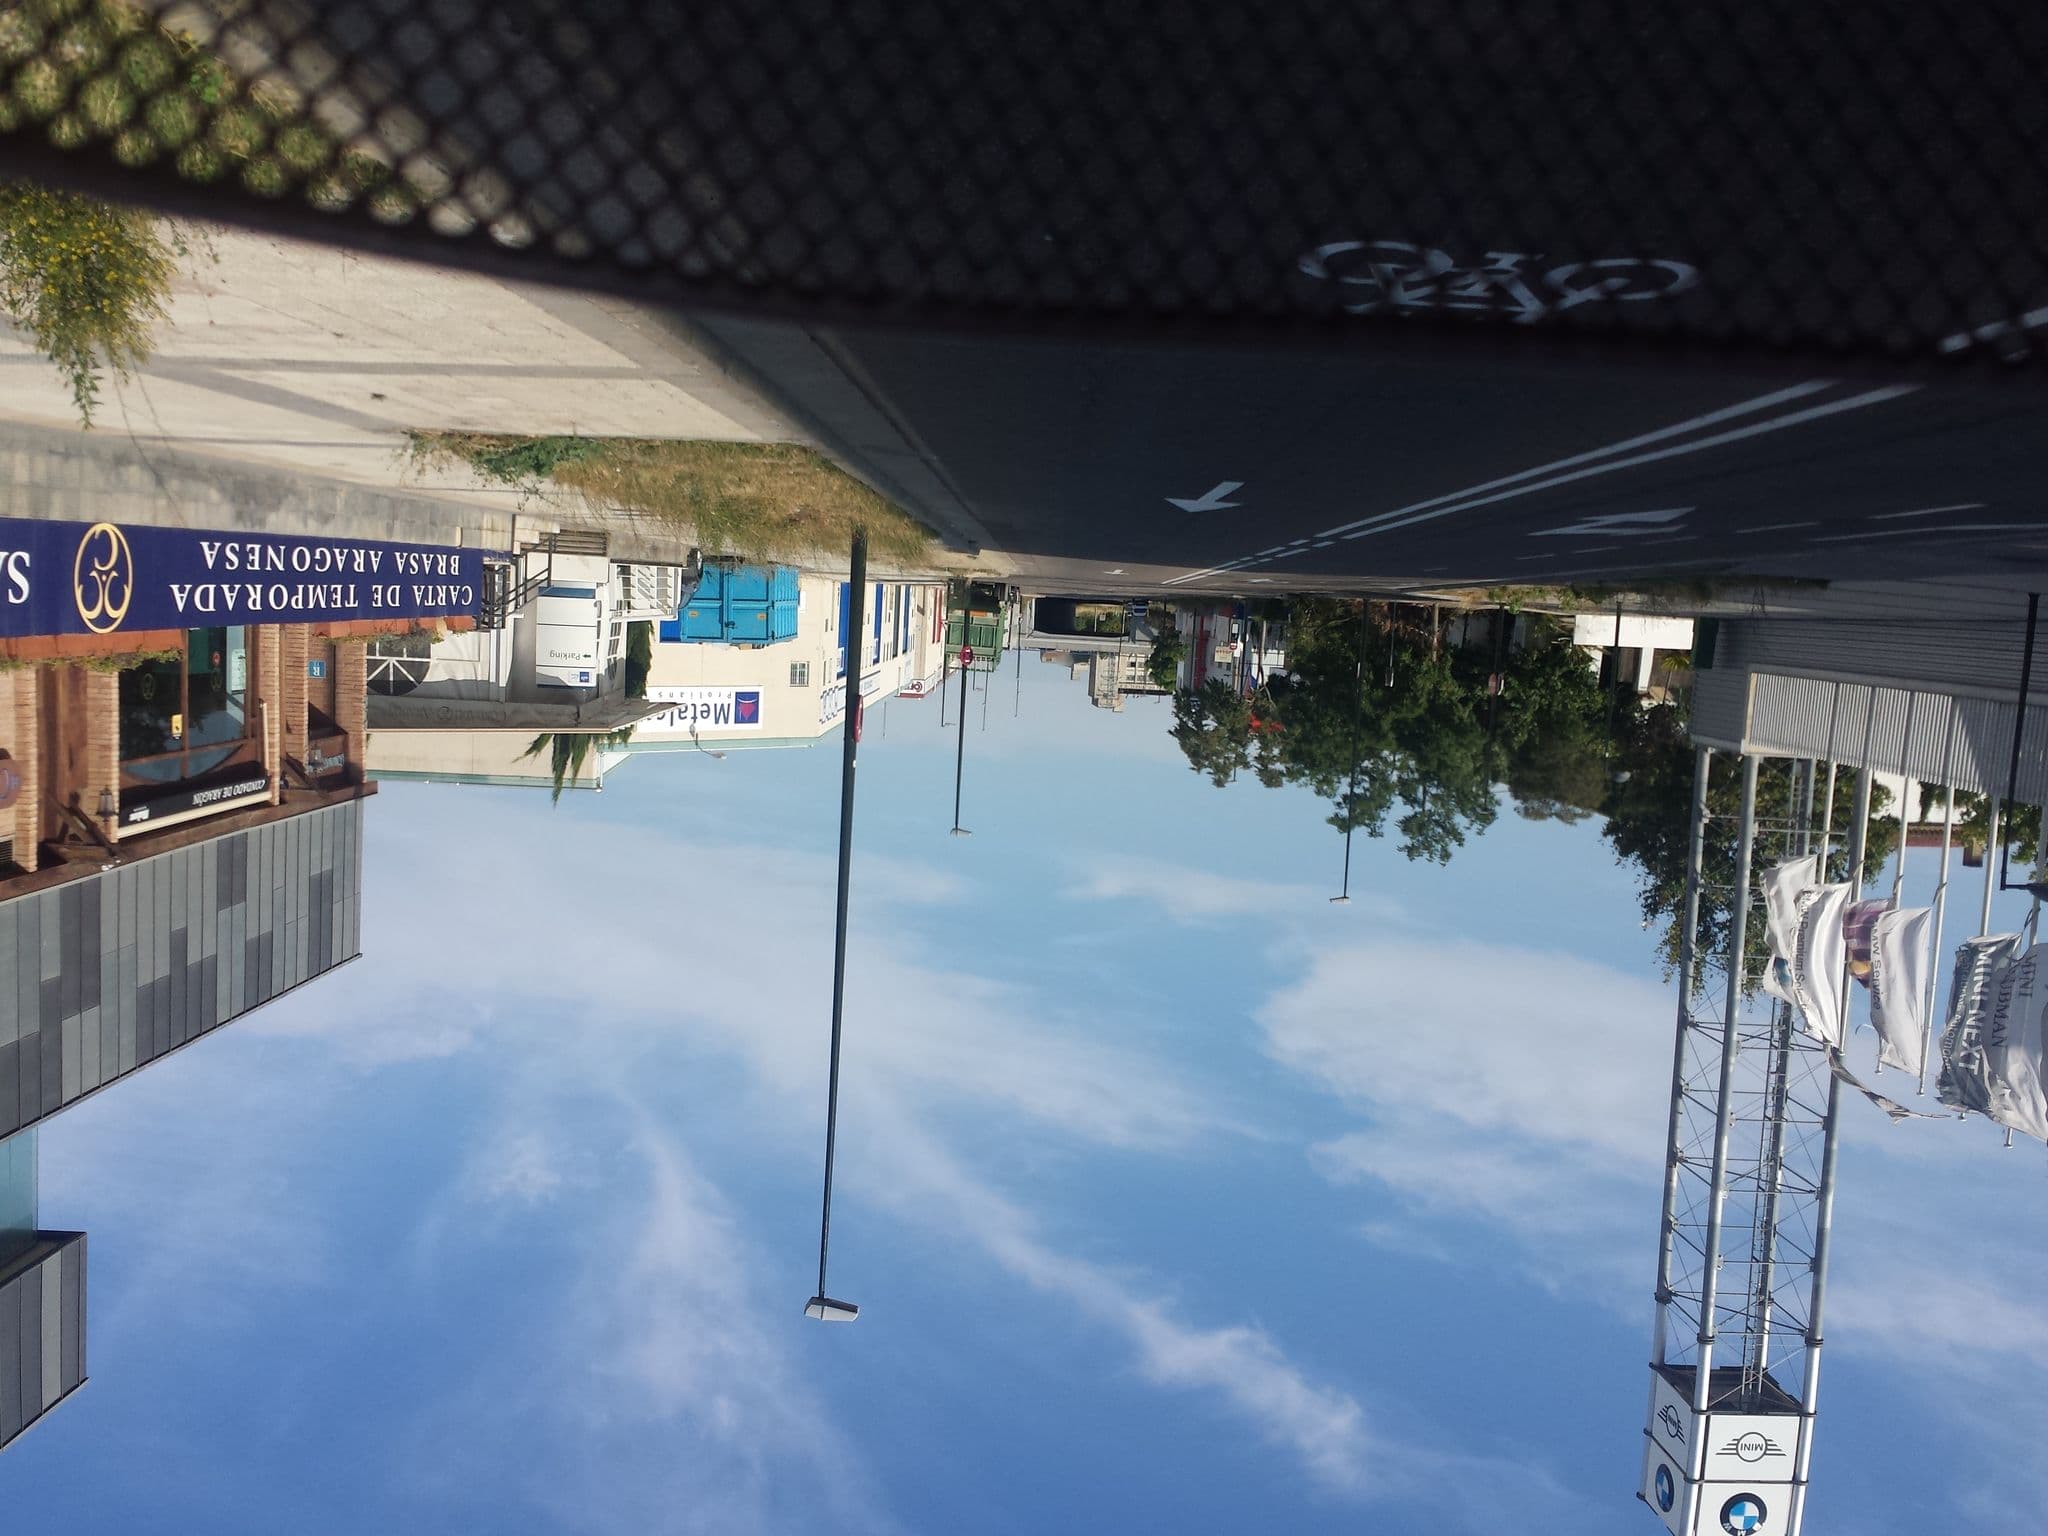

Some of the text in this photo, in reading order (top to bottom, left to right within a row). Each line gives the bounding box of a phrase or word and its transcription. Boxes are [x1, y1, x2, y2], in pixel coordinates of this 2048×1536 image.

[199, 541, 460, 576] BRASA ARAGONESA
[0, 551, 31, 604] S
[169, 583, 473, 613] CARTA DE TEMPORADA
[549, 649, 580, 661] Parking
[312, 666, 320, 677] R
[657, 691, 732, 699] Prolians
[222, 786, 232, 798] DE
[233, 779, 265, 796] CONDADO
[1795, 921, 1809, 970] Premium
[1872, 960, 1883, 1010] Service
[1958, 1010, 1985, 1075] NEXT
[1740, 1443, 1763, 1451] MINI
